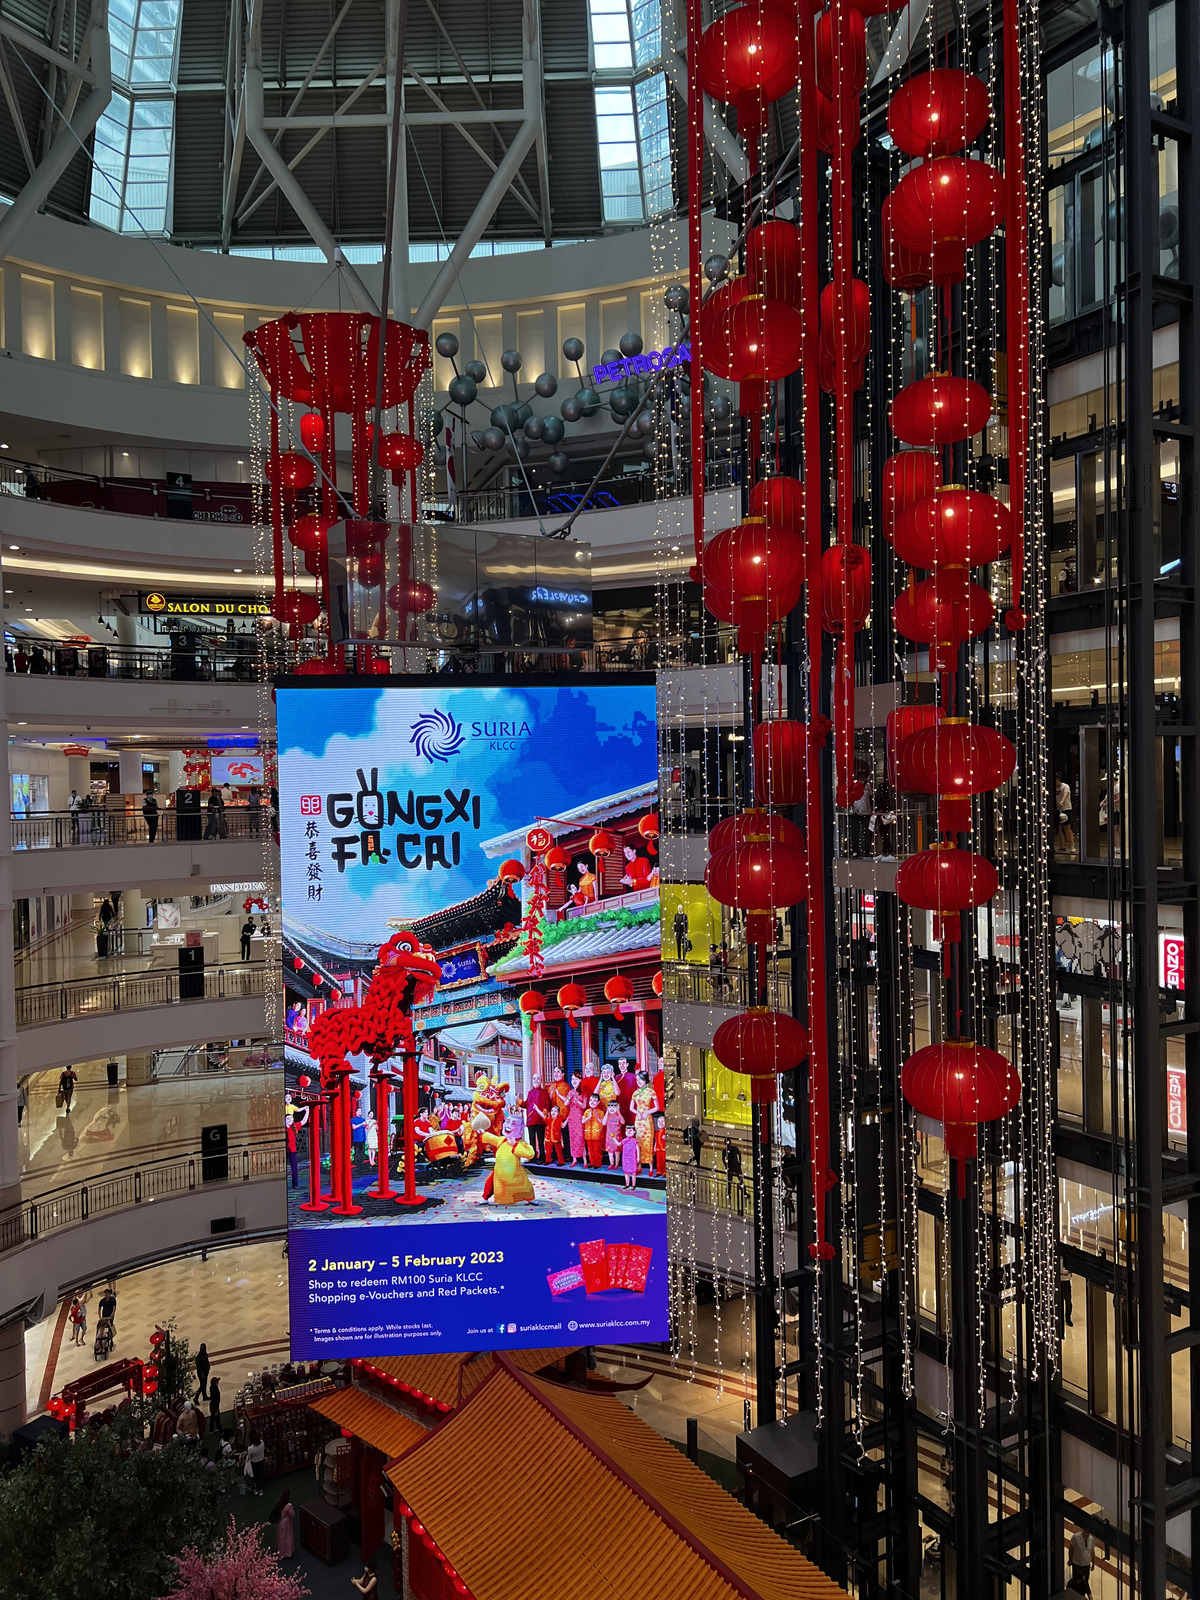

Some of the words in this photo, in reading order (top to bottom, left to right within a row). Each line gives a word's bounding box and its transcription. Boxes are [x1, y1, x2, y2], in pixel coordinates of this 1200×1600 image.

[593, 343, 691, 385] PETROSA
[175, 475, 185, 487] 4
[1171, 483, 1177, 494] 3
[167, 603, 210, 613] SALON
[216, 604, 235, 614] DU
[238, 604, 271, 614] CHO
[178, 635, 188, 646] 3
[471, 721, 533, 737] SURIA
[489, 741, 517, 751] KLCC
[184, 792, 193, 804] 2
[327, 770, 480, 830] GONGXI
[304, 820, 323, 902] 恭喜發財
[210, 881, 266, 893] PANDORA
[188, 949, 195, 961] 1
[457, 958, 476, 967] SURIA
[209, 1129, 221, 1141] G
[308, 1259, 317, 1272] 2
[321, 1258, 375, 1273] January
[391, 1255, 400, 1267] 5
[404, 1254, 466, 1268] February
[470, 1251, 504, 1264] 2023
[308, 1279, 334, 1290] Shop
[337, 1280, 348, 1288] to
[350, 1277, 388, 1287] redeem
[391, 1274, 426, 1285] RM100
[428, 1273, 453, 1283] Suria
[456, 1272, 483, 1282] KLCC
[308, 1292, 357, 1304] Shopping
[359, 1289, 414, 1301] e-Vouchers
[416, 1288, 435, 1298] and
[438, 1286, 457, 1296] Red
[519, 1322, 562, 1332] suriaklccmall
[579, 1319, 651, 1329] www.suriaklcc.com.my
[430, 1329, 443, 1337] only.
